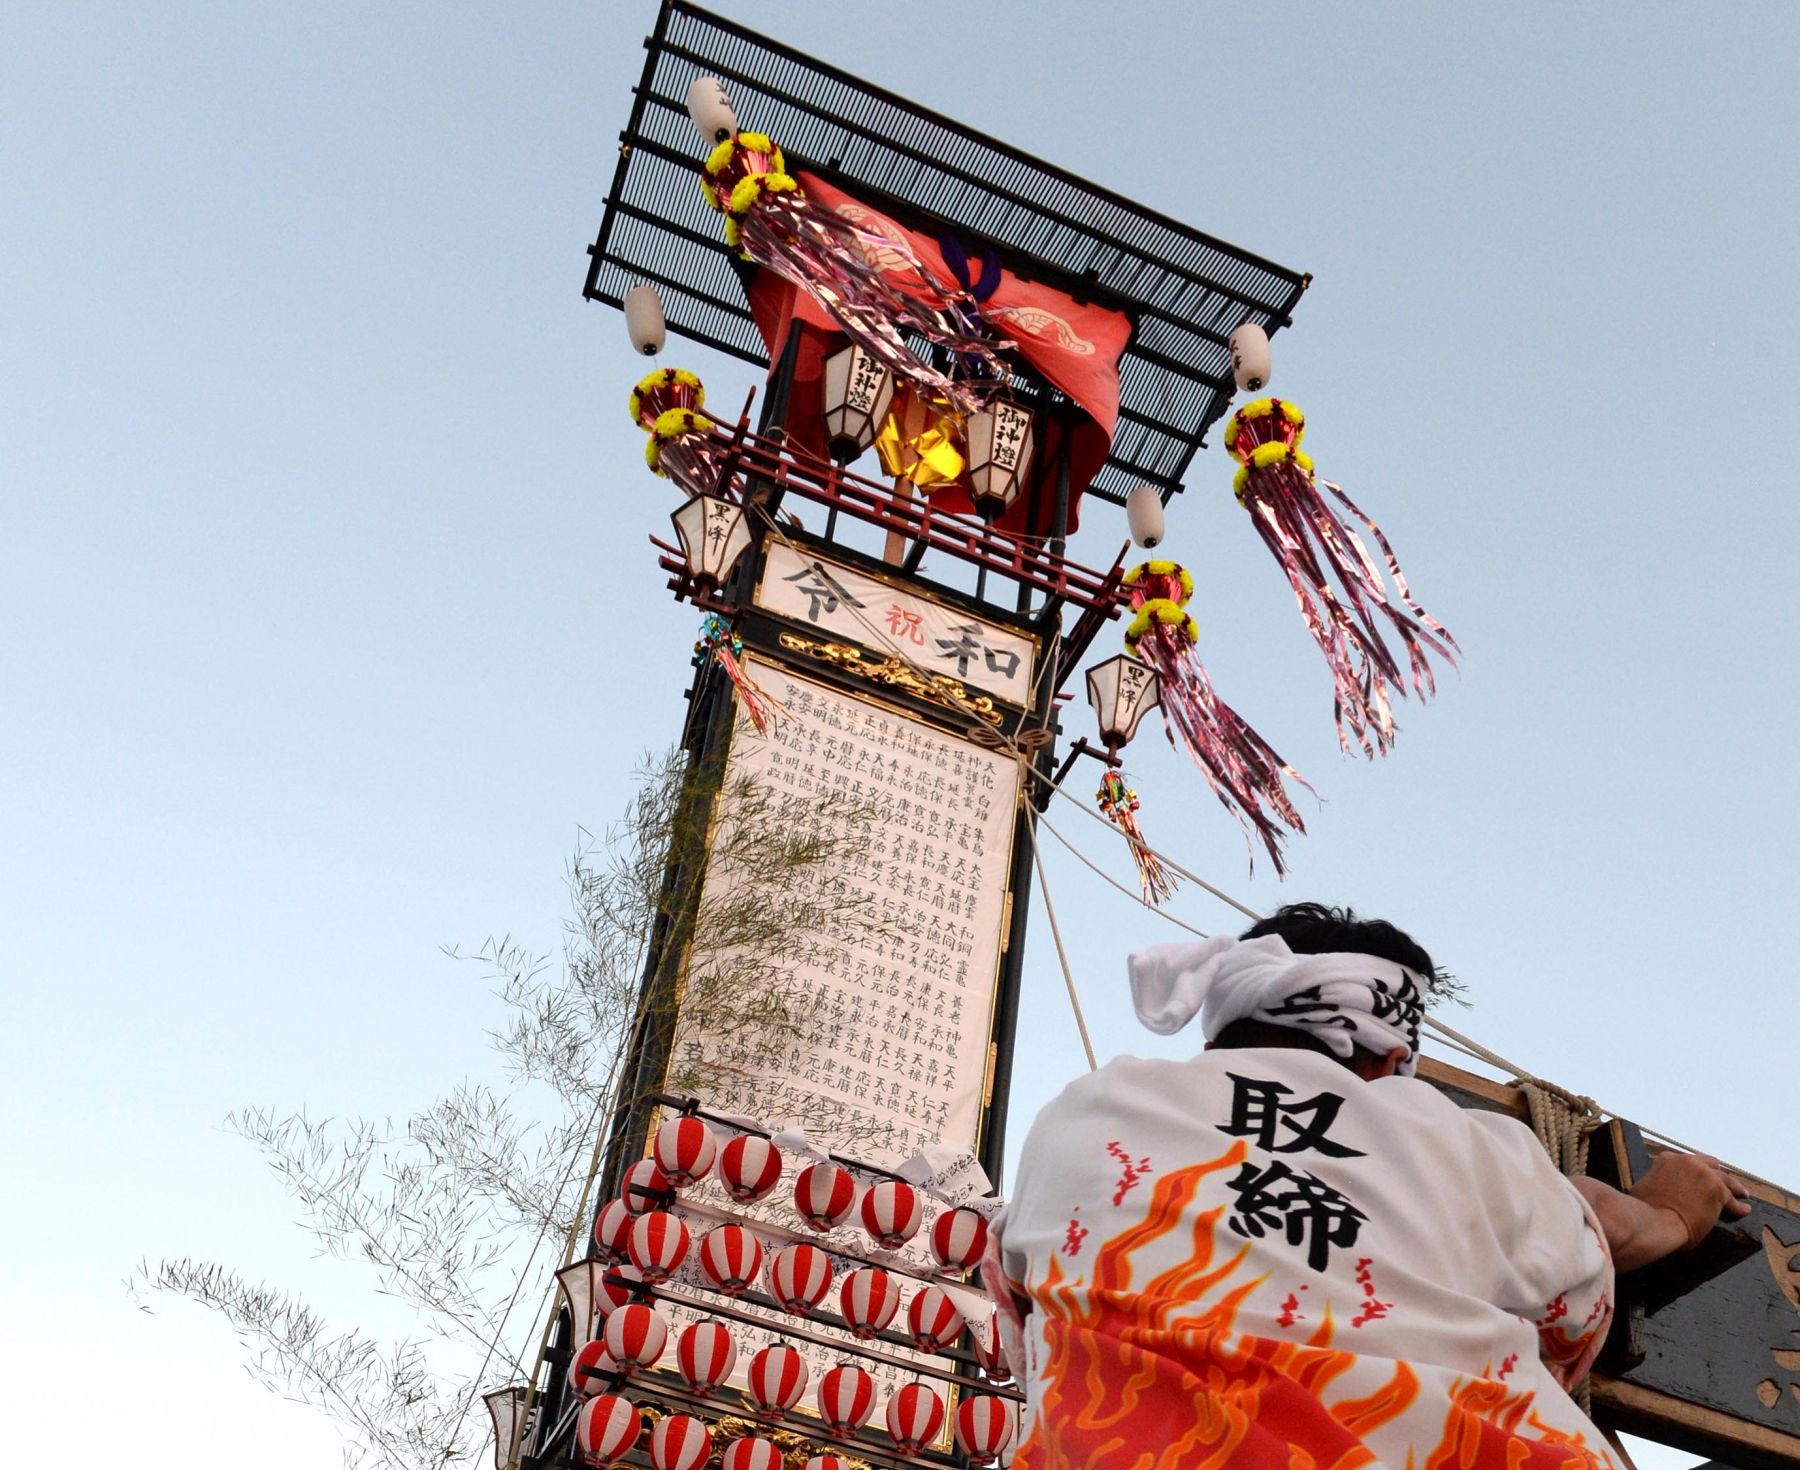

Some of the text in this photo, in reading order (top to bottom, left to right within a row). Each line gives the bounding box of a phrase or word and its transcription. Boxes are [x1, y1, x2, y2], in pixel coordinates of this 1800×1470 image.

[994, 407, 1026, 467] 御神燈
[708, 503, 731, 556] 黒峰
[1120, 665, 1144, 714] 黒峰
[1215, 1072, 1367, 1272] 取締
